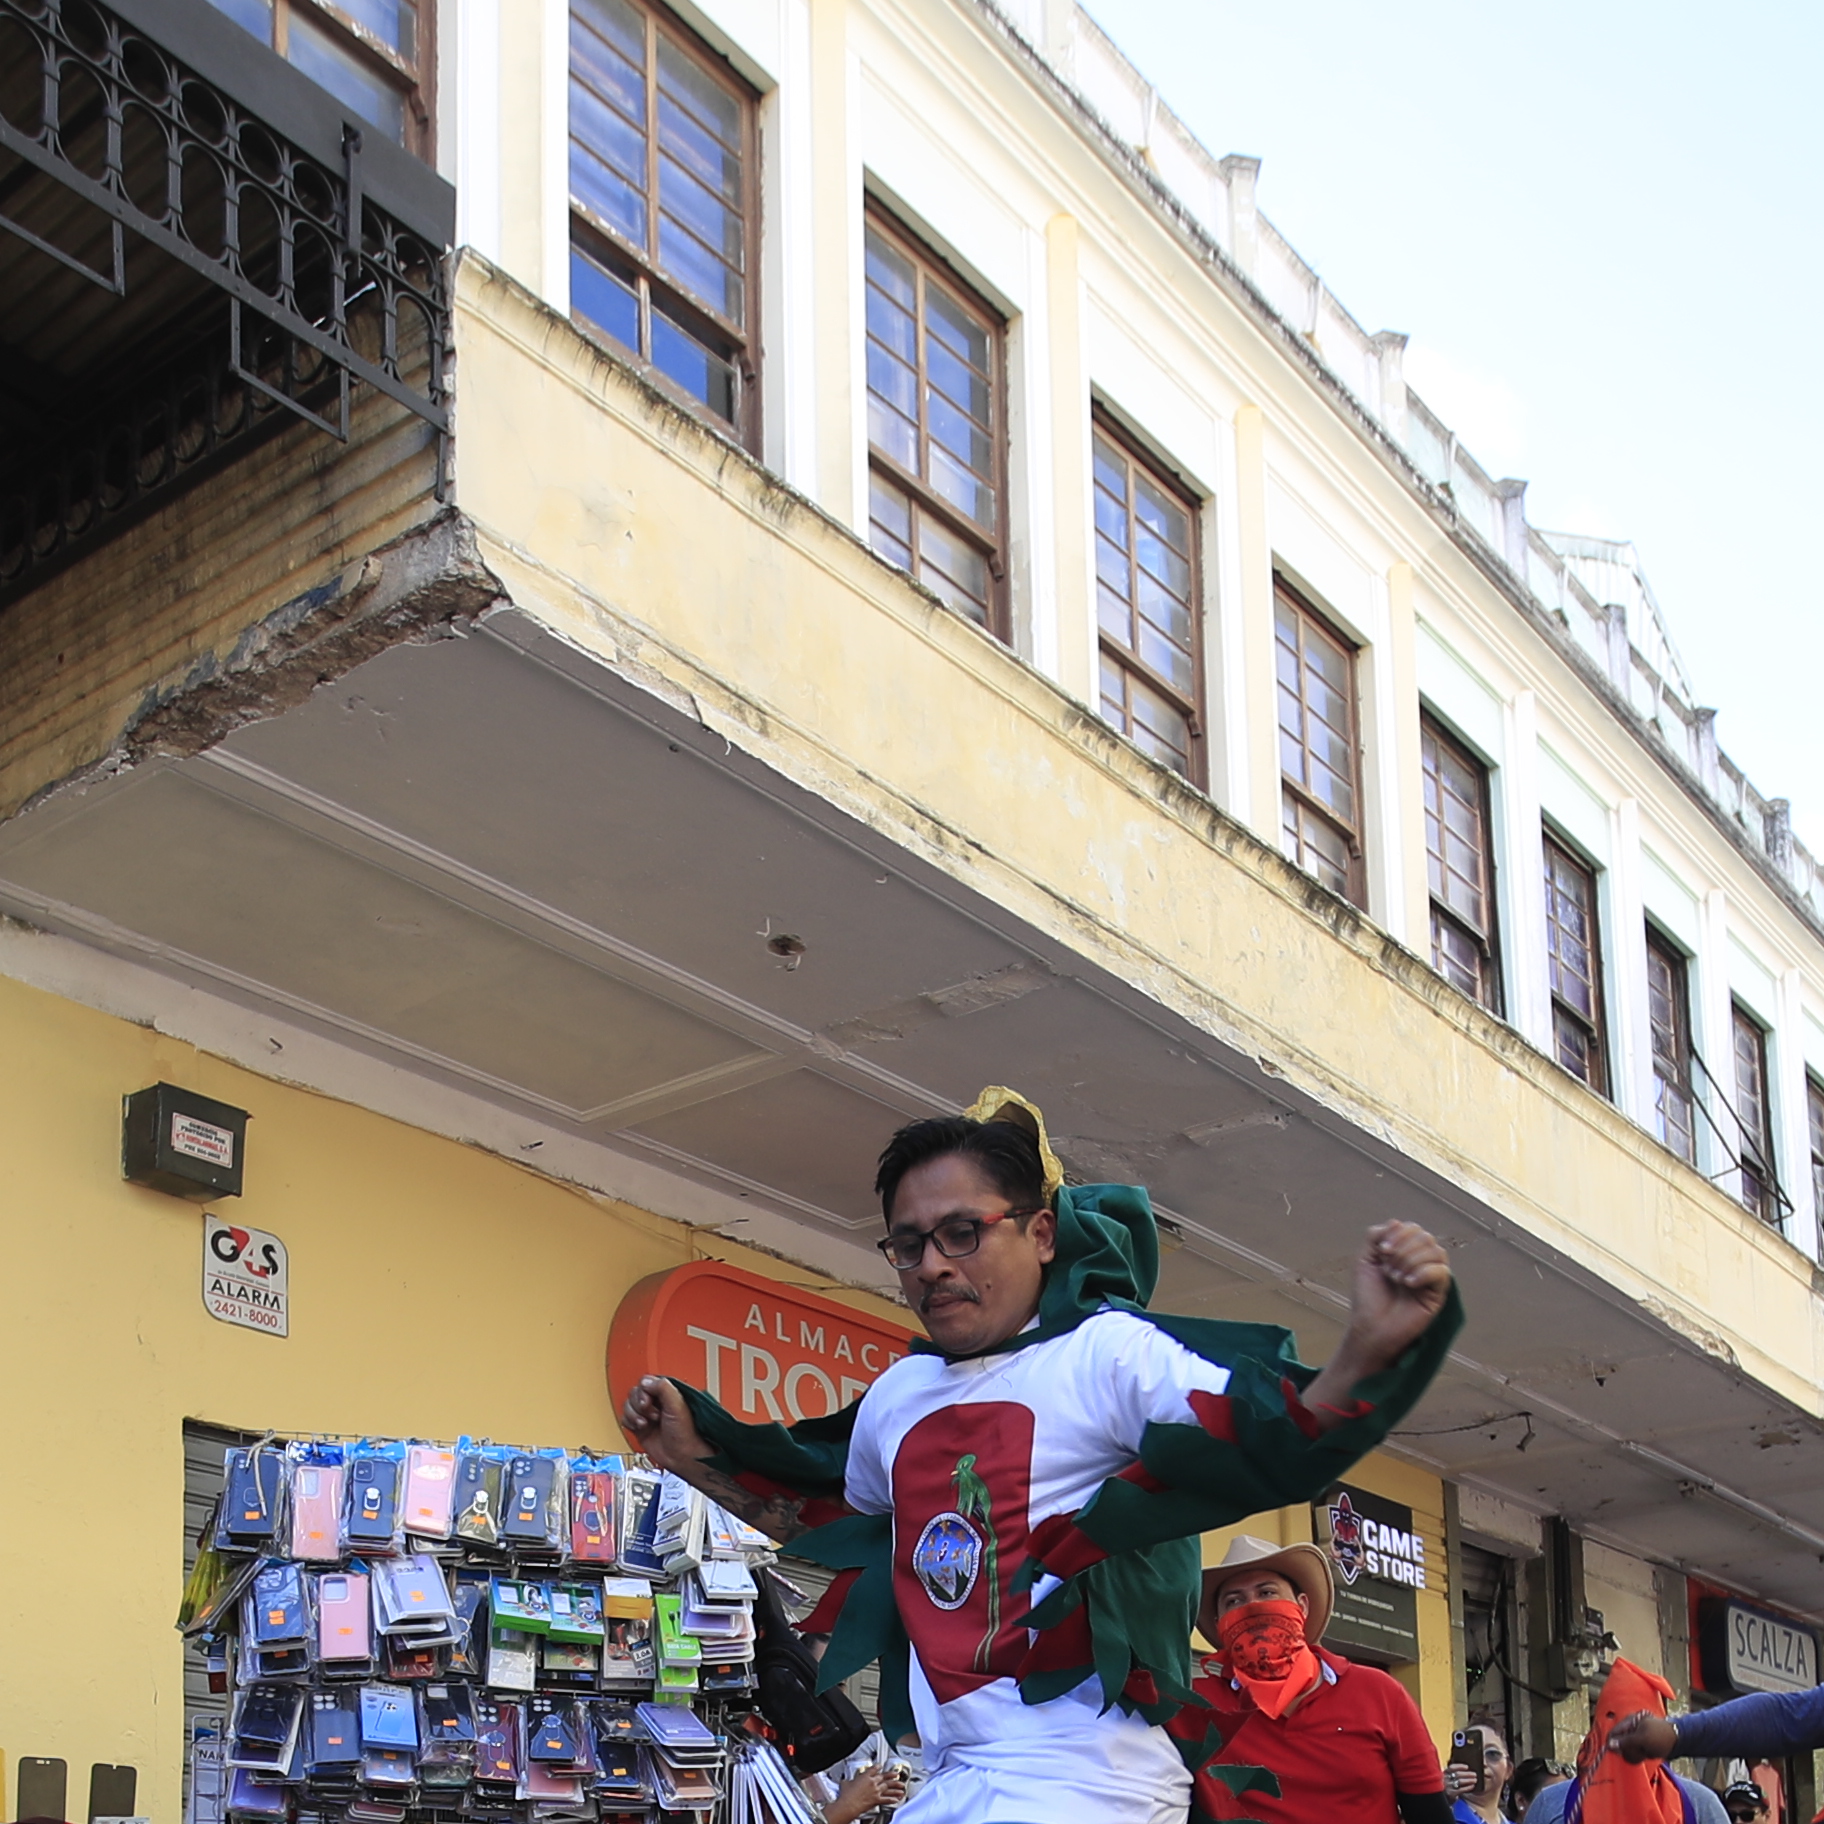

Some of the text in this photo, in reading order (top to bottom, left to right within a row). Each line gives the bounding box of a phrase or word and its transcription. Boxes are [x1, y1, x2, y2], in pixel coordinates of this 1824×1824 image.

[210, 1226, 279, 1279] G4S
[210, 1278, 281, 1311] ALARM
[213, 1299, 279, 1328] 2421-8000
[1362, 1518, 1425, 1564] GAME
[1365, 1550, 1427, 1590] STORE
[1735, 1612, 1808, 1679] SCALZA
